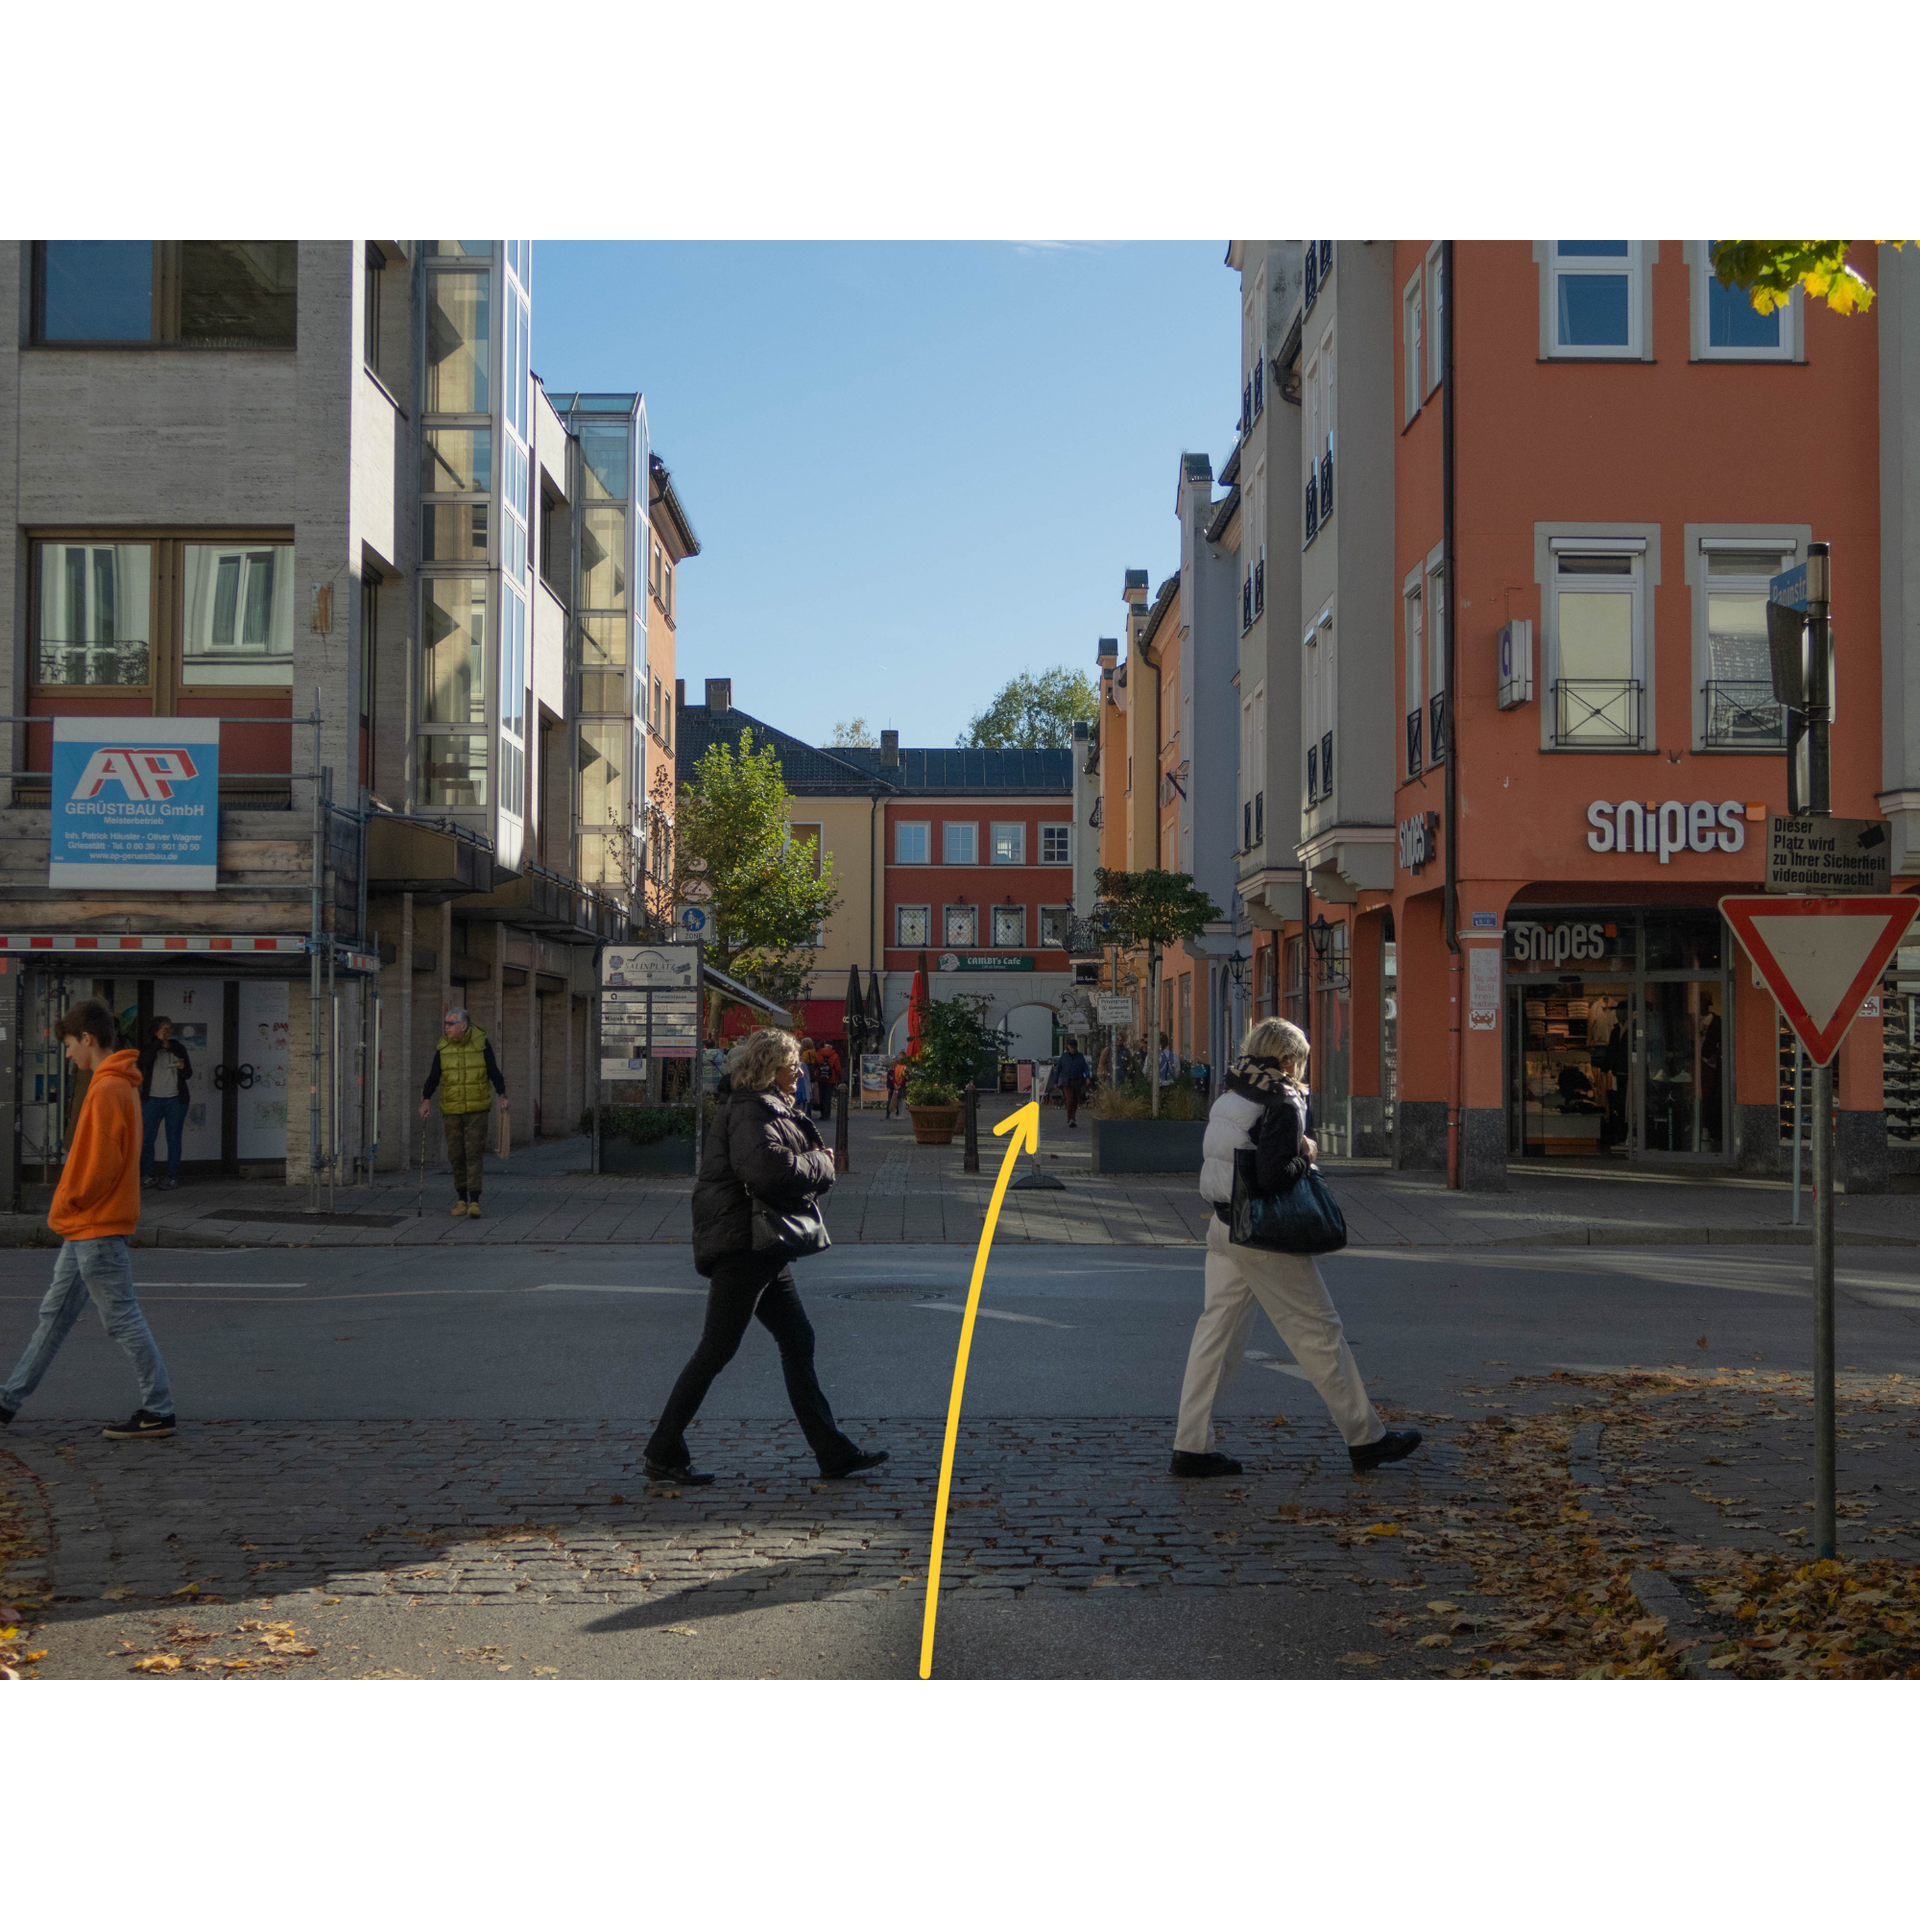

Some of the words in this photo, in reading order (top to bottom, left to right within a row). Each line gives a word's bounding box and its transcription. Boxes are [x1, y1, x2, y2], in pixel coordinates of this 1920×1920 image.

[70, 747, 199, 801] AP
[65, 801, 155, 815] GERÜSTBAU
[160, 804, 204, 816] GmbH
[104, 816, 164, 825] Meisterbetrieb
[1774, 818, 1813, 833] Dieser
[65, 832, 79, 840] Inh.
[82, 832, 108, 840] Patrick
[147, 833, 170, 842] Oliver
[172, 834, 202, 843] Wagner
[1587, 800, 1744, 864] snipes
[112, 842, 124, 850] Tel.
[178, 843, 188, 851] 50
[190, 843, 200, 851] 50
[1399, 813, 1427, 876] snipes
[1774, 835, 1804, 850] Platz
[1808, 837, 1835, 851] wird
[89, 852, 177, 861] www.ap-geruestbau.de
[1773, 854, 1787, 866] zu
[1791, 852, 1820, 867] Ihrer
[1823, 854, 1886, 870] Sicherheit
[1772, 868, 1874, 886] videoüberwacht!
[1514, 924, 1605, 967] snipes
